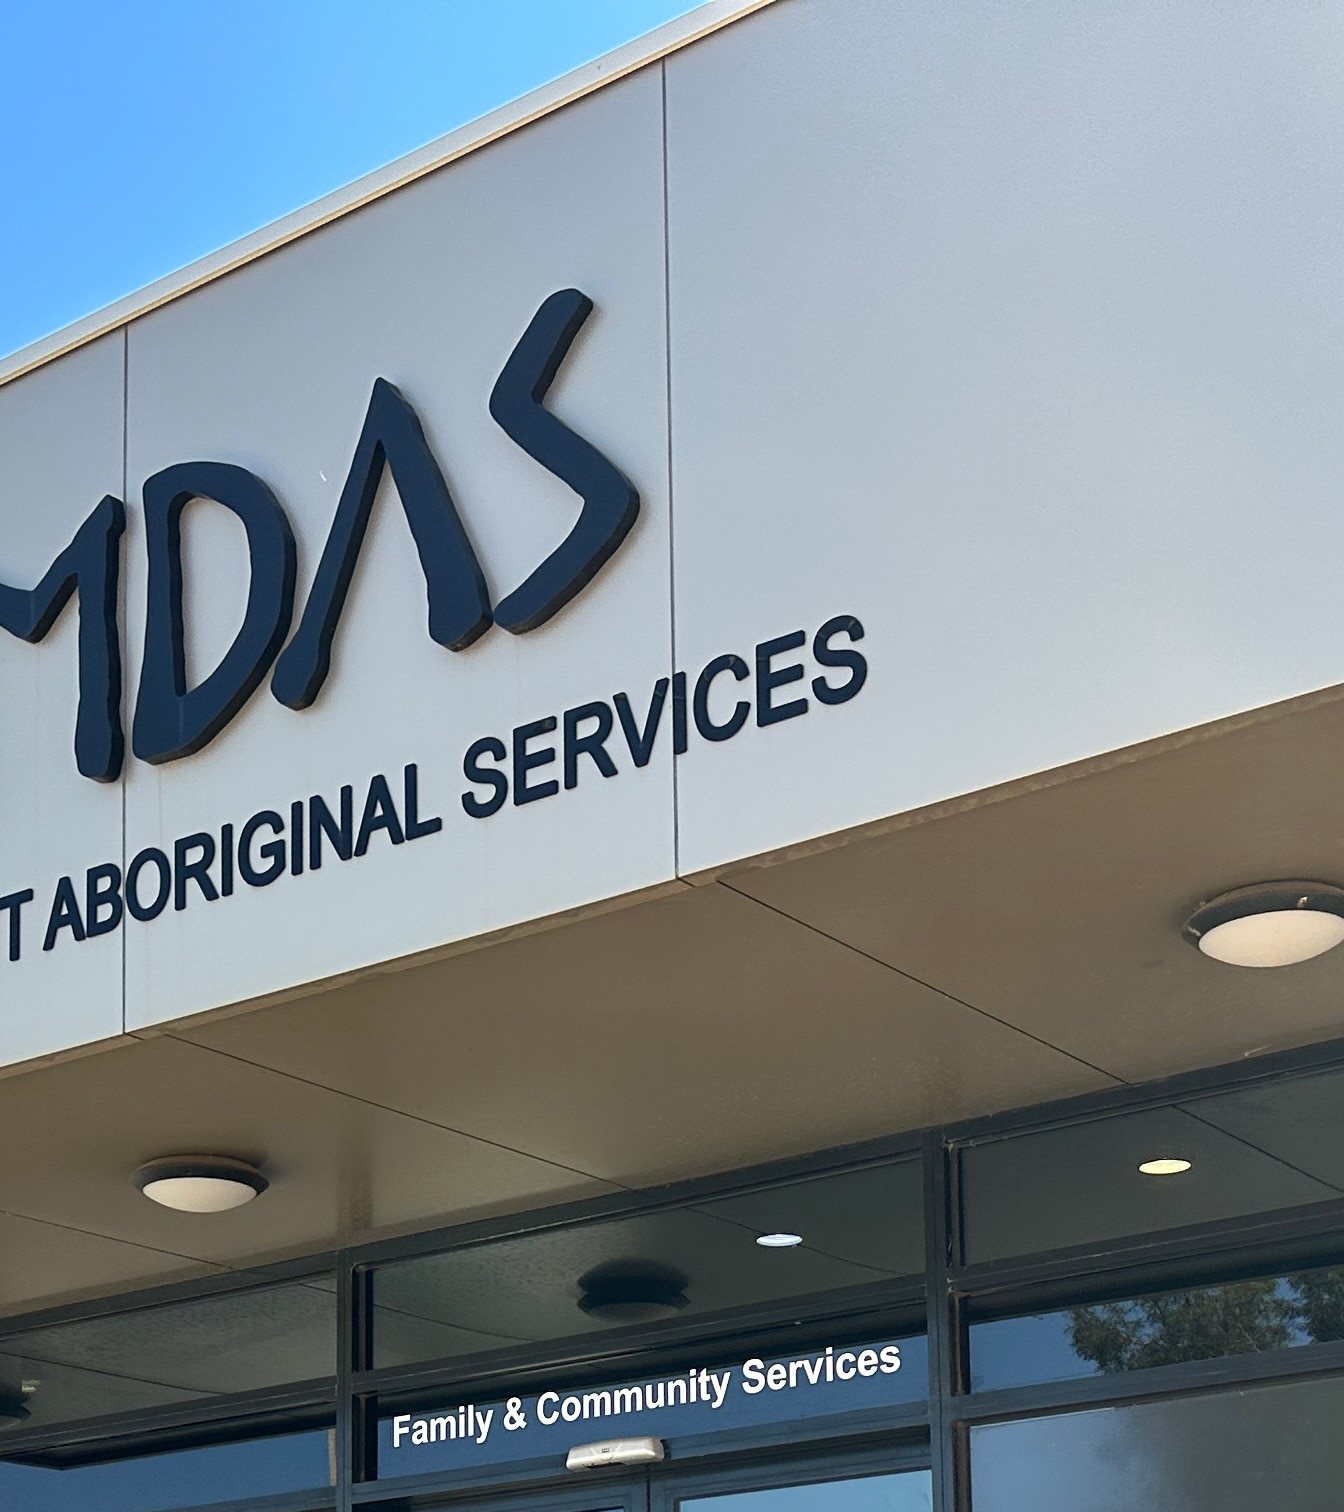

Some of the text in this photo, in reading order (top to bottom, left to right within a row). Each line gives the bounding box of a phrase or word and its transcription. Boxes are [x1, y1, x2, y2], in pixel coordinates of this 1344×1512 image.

[43, 763, 443, 951] ABORIGINAL
[460, 614, 868, 820] SERVICES
[392, 1342, 902, 1448] Family & Community Services
